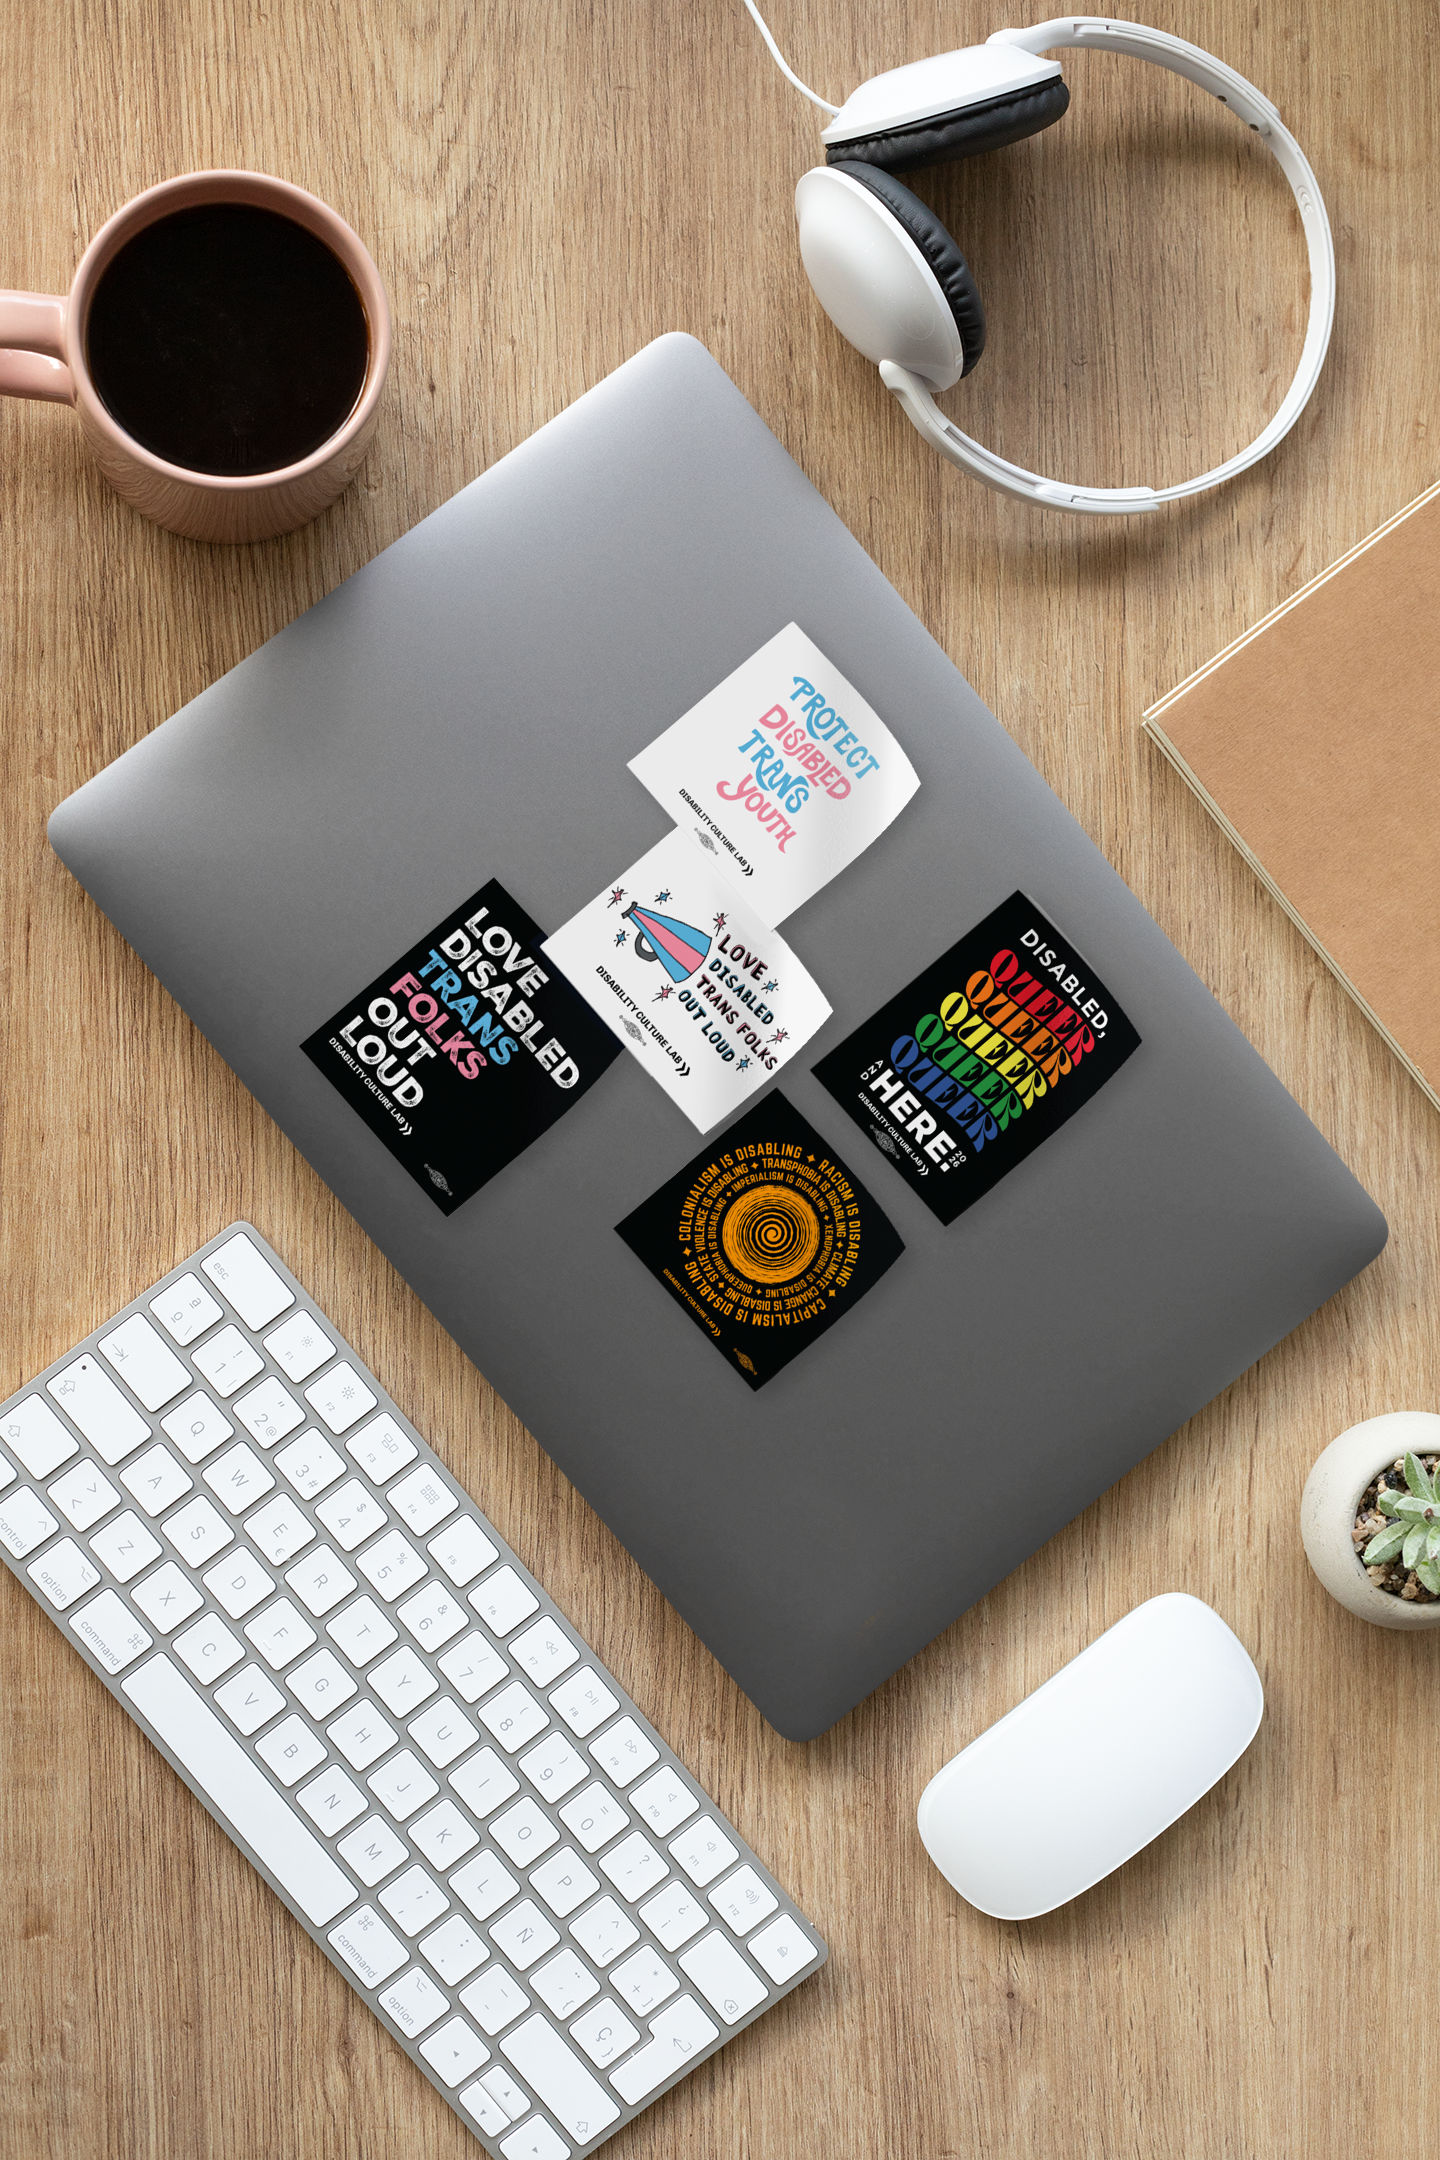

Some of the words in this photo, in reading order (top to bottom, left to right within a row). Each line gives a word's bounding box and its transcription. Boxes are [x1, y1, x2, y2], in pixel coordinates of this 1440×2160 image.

[789, 676, 880, 779] PROTECT
[758, 703, 852, 800] DISABLED
[737, 728, 810, 813] TRANS
[716, 773, 797, 854] YOUTH
[678, 788, 712, 827] DISABILITY
[710, 824, 737, 854] CULTURE
[733, 851, 748, 867] LAB
[464, 906, 550, 998] LOVE
[717, 933, 768, 981] LOVE
[708, 958, 774, 1025] DISABLED
[1019, 928, 1109, 1039] DISABLED,
[418, 948, 519, 1065] TRANS
[439, 928, 580, 1089] DISABLED
[990, 949, 1095, 1067] QUEER
[595, 965, 638, 1013] DISABILITY
[635, 1011, 669, 1050] CULTURE
[664, 1046, 683, 1065] LAB
[696, 973, 740, 1024] TRANS
[735, 1022, 778, 1071] FOLKS
[367, 996, 437, 1066] OUT
[389, 971, 488, 1080] FOLKS
[678, 989, 707, 1021] OUT
[701, 1020, 735, 1063] LOUD
[965, 970, 1072, 1089] QUEER
[939, 991, 1048, 1111] QUEER
[339, 1014, 424, 1108] LOUD
[915, 1013, 1023, 1132] QUEER
[328, 1037, 367, 1079] DISABILITY
[364, 1077, 393, 1111] CULTURE
[390, 1108, 406, 1125] LAB
[890, 1034, 998, 1153] QUEER
[868, 1068, 957, 1173] HERE.
[857, 1092, 891, 1128] DISABILITY
[887, 1126, 914, 1158] CULTURE
[909, 1153, 924, 1167] LAB
[707, 1163, 749, 1199] DISABLING
[818, 1159, 854, 1201] RACISM
[678, 1163, 721, 1241] COLONIALISM
[719, 1153, 734, 1169] IS
[735, 1142, 803, 1161] DISABLING
[731, 1171, 784, 1193] IMPERIALISM
[795, 1178, 828, 1213] DISABLING
[761, 1157, 822, 1185] TRANSPHOBIA
[819, 1180, 831, 1193] IS
[825, 1189, 847, 1238] DISABLING
[701, 1197, 713, 1208] IS
[845, 1202, 859, 1217] IS
[707, 1197, 727, 1240] DISABLING
[694, 1207, 709, 1253] VIOLENCE
[812, 1223, 834, 1274] XENOPHOBIA
[835, 1220, 861, 1288] DISABLING
[213, 1262, 229, 1280] esc
[697, 1253, 719, 1283] STATE
[711, 1251, 753, 1294] QUEERPHOBIA
[815, 1251, 843, 1291] CLIMATE
[684, 1261, 734, 1316] DISABLING
[765, 1278, 808, 1298] DISABLING
[724, 1287, 771, 1311] DISABLING
[773, 1300, 783, 1311] IS
[784, 1285, 820, 1310] CHANGE
[735, 1308, 749, 1323] IS
[752, 1298, 827, 1327] CAPITALISM
[285, 1351, 293, 1360] F1
[215, 1363, 226, 1373] 1
[326, 1402, 335, 1412] F2
[191, 1421, 205, 1437] Q
[254, 1414, 270, 1428] 2
[367, 1453, 376, 1463] F3
[231, 1469, 249, 1487] W
[296, 1465, 309, 1477] 3
[148, 1476, 162, 1489] A
[408, 1504, 417, 1514] F4
[273, 1523, 288, 1537] E
[338, 1518, 351, 1528] 4
[191, 1526, 205, 1540] S
[118, 1540, 134, 1555] Z
[447, 1555, 457, 1565] F5
[377, 1566, 392, 1579] 5
[40, 1571, 68, 1602] option
[231, 1575, 246, 1590] D
[313, 1574, 328, 1589] R
[159, 1591, 176, 1606] X
[488, 1605, 497, 1615] F6
[273, 1627, 288, 1637] F
[357, 1624, 371, 1637] T
[419, 1618, 433, 1630] 6
[80, 1621, 122, 1667] command
[202, 1643, 216, 1656] C
[529, 1657, 538, 1665] F7
[459, 1667, 473, 1677] 7
[315, 1678, 329, 1692] G
[398, 1675, 411, 1687] Y
[245, 1692, 259, 1705] V
[569, 1707, 579, 1717] F8
[437, 1725, 452, 1740] U
[500, 1718, 513, 1731] 8
[355, 1727, 371, 1743] H
[283, 1744, 298, 1758] B
[610, 1757, 619, 1765] F9
[540, 1768, 553, 1781] 9
[397, 1783, 411, 1792] J
[324, 1794, 341, 1809] N
[649, 1805, 660, 1817] F10
[581, 1818, 594, 1830] 0
[436, 1828, 452, 1844] K
[518, 1827, 532, 1840] O
[365, 1843, 382, 1860] M
[689, 1855, 699, 1866] F11
[477, 1879, 488, 1893] L
[557, 1875, 572, 1886] P
[728, 1904, 739, 1916] F12
[517, 1928, 534, 1944] Ñ
[337, 1934, 377, 1979] command
[388, 1996, 415, 2027] option
[596, 2027, 612, 2042] Ç
